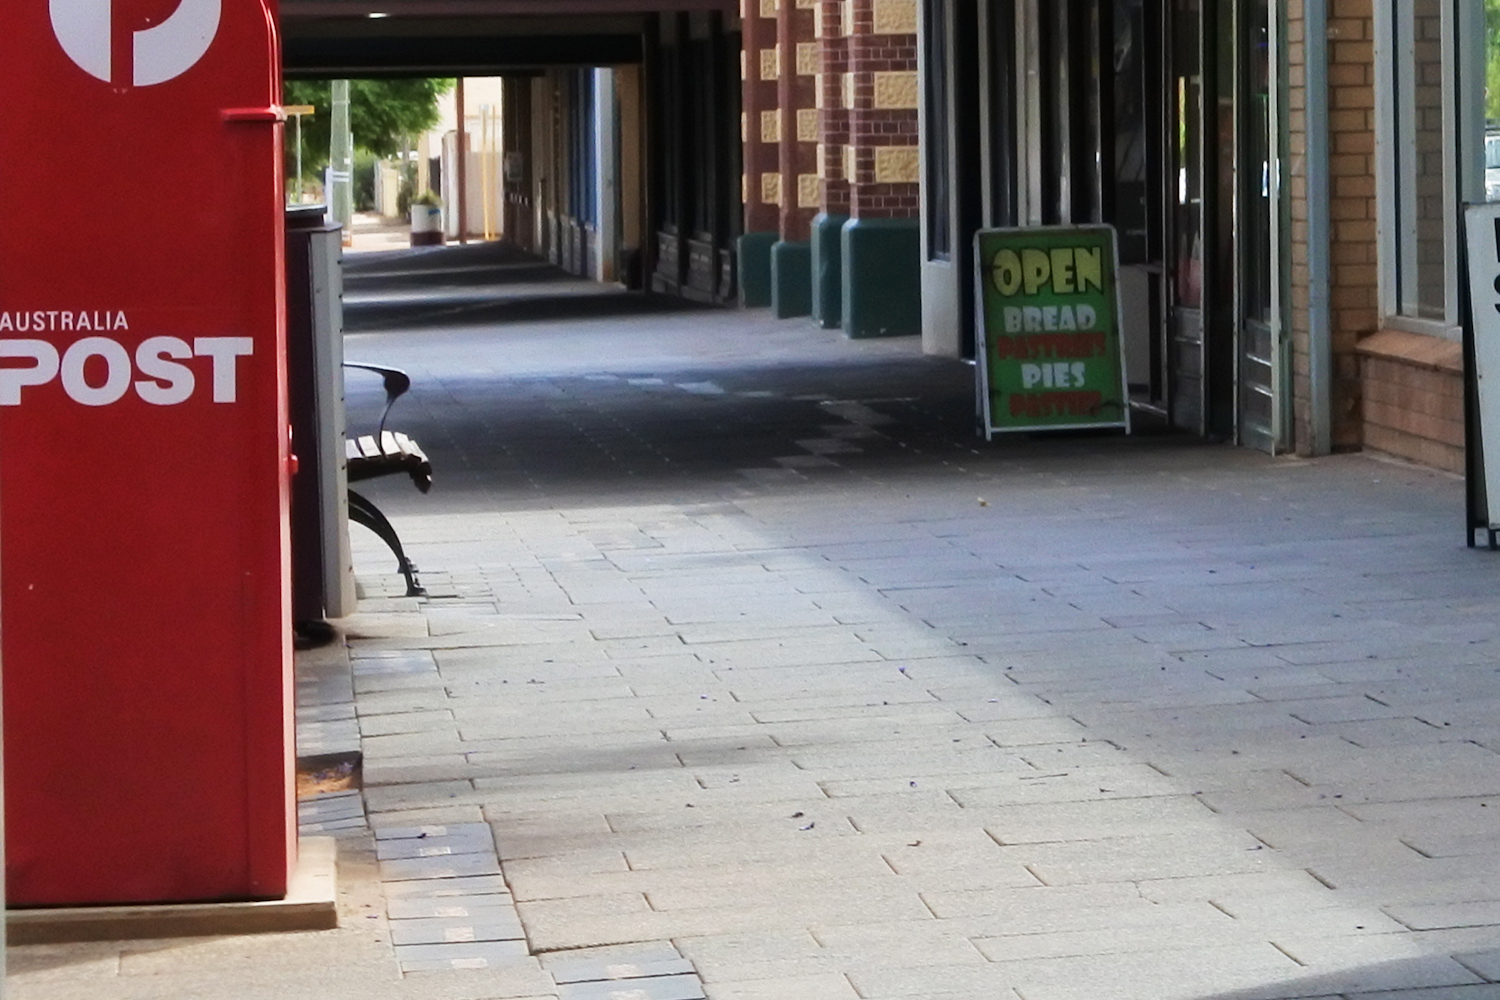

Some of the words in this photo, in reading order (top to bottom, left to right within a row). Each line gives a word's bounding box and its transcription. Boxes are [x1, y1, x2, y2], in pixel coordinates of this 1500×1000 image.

[992, 246, 1104, 296] OPEN
[0, 310, 129, 332] AUSTRALIA
[1003, 303, 1097, 333] BREAD
[0, 335, 254, 407] POST
[1021, 362, 1085, 389] PIES
